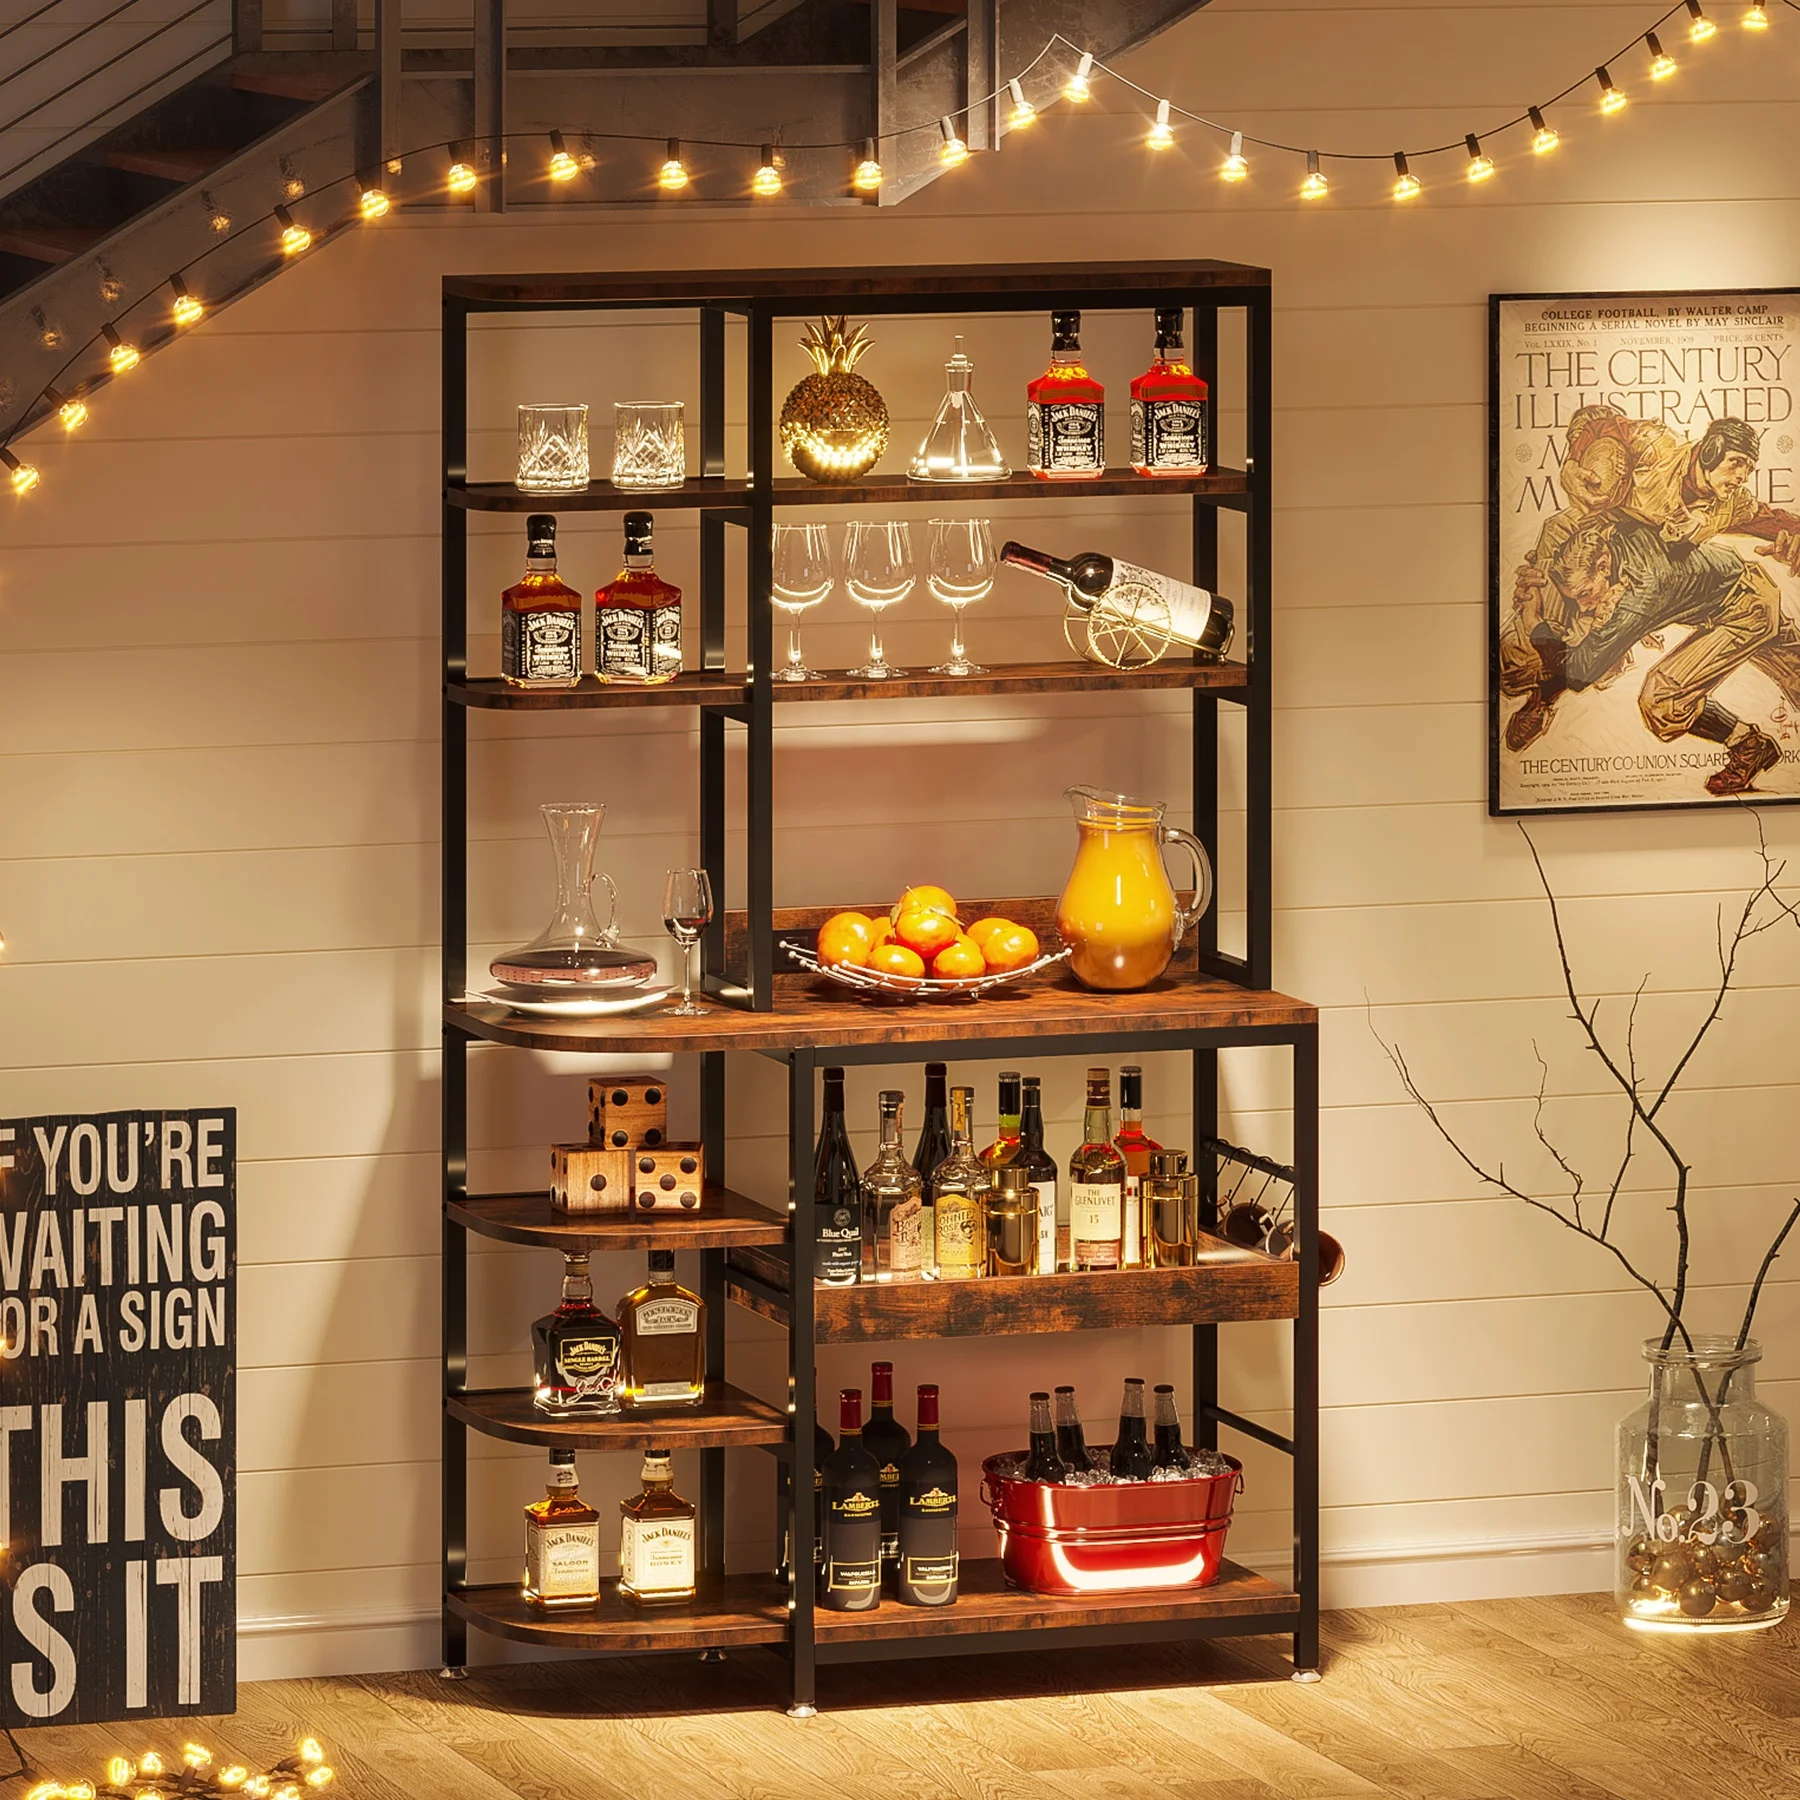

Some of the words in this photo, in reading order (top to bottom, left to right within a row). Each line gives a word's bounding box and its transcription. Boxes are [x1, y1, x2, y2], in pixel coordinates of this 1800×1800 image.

[1541, 310, 1592, 320] COLLEGE
[1598, 308, 1660, 319] FOOTBALL,
[1668, 307, 1682, 317] BY
[1686, 305, 1732, 316] WALTER
[1737, 304, 1768, 315] CAMP
[1524, 321, 1585, 333] BEGINNING
[1589, 321, 1598, 331] A
[1601, 320, 1640, 330] SERIAL
[1645, 318, 1682, 329] NOVEL
[1686, 317, 1701, 327] BY
[1704, 317, 1729, 327] MAY
[1734, 315, 1784, 326] SINCLAIR
[1755, 332, 1784, 342] CENTS
[1514, 350, 1600, 388] THE
[1608, 344, 1792, 387] CENTURY
[1520, 759, 1549, 775] THE
[1549, 756, 1612, 774] CENTURY
[33, 1118, 225, 1196] YOU'RE
[1087, 1189, 1100, 1197] THE
[1075, 1195, 1115, 1206] GLENLIVET
[1089, 1214, 1099, 1224] 15
[822, 1227, 840, 1238] Blue
[73, 1293, 104, 1355] A
[119, 1286, 225, 1353] SIGN
[0, 1393, 223, 1549] THIS
[832, 1499, 880, 1511] LAMBERTI
[909, 1495, 957, 1506] LAMBERTI
[546, 1536, 565, 1549] JACK
[642, 1530, 660, 1543] JACK
[125, 1555, 223, 1708] IT
